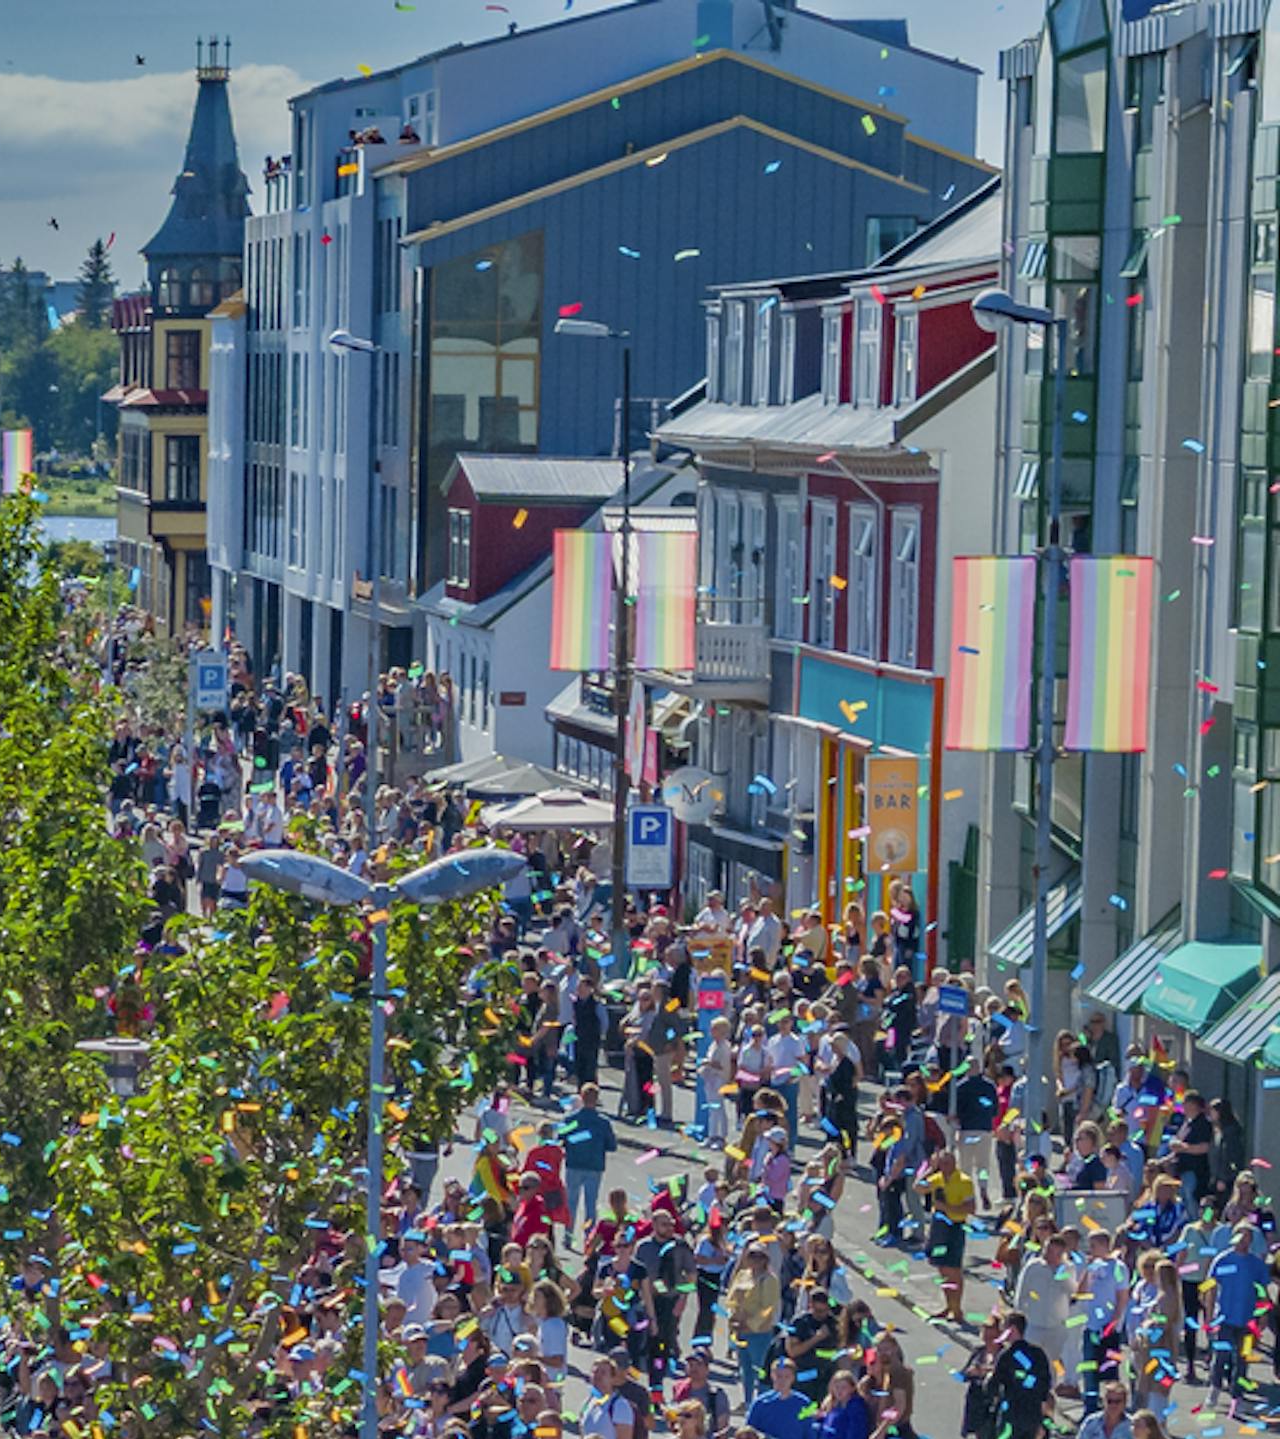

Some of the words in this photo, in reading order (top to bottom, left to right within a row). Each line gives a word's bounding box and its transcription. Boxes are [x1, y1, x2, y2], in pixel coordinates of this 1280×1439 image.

[204, 669, 219, 686] P
[681, 782, 704, 805] M
[873, 794, 913, 810] BAR
[640, 816, 662, 840] P
